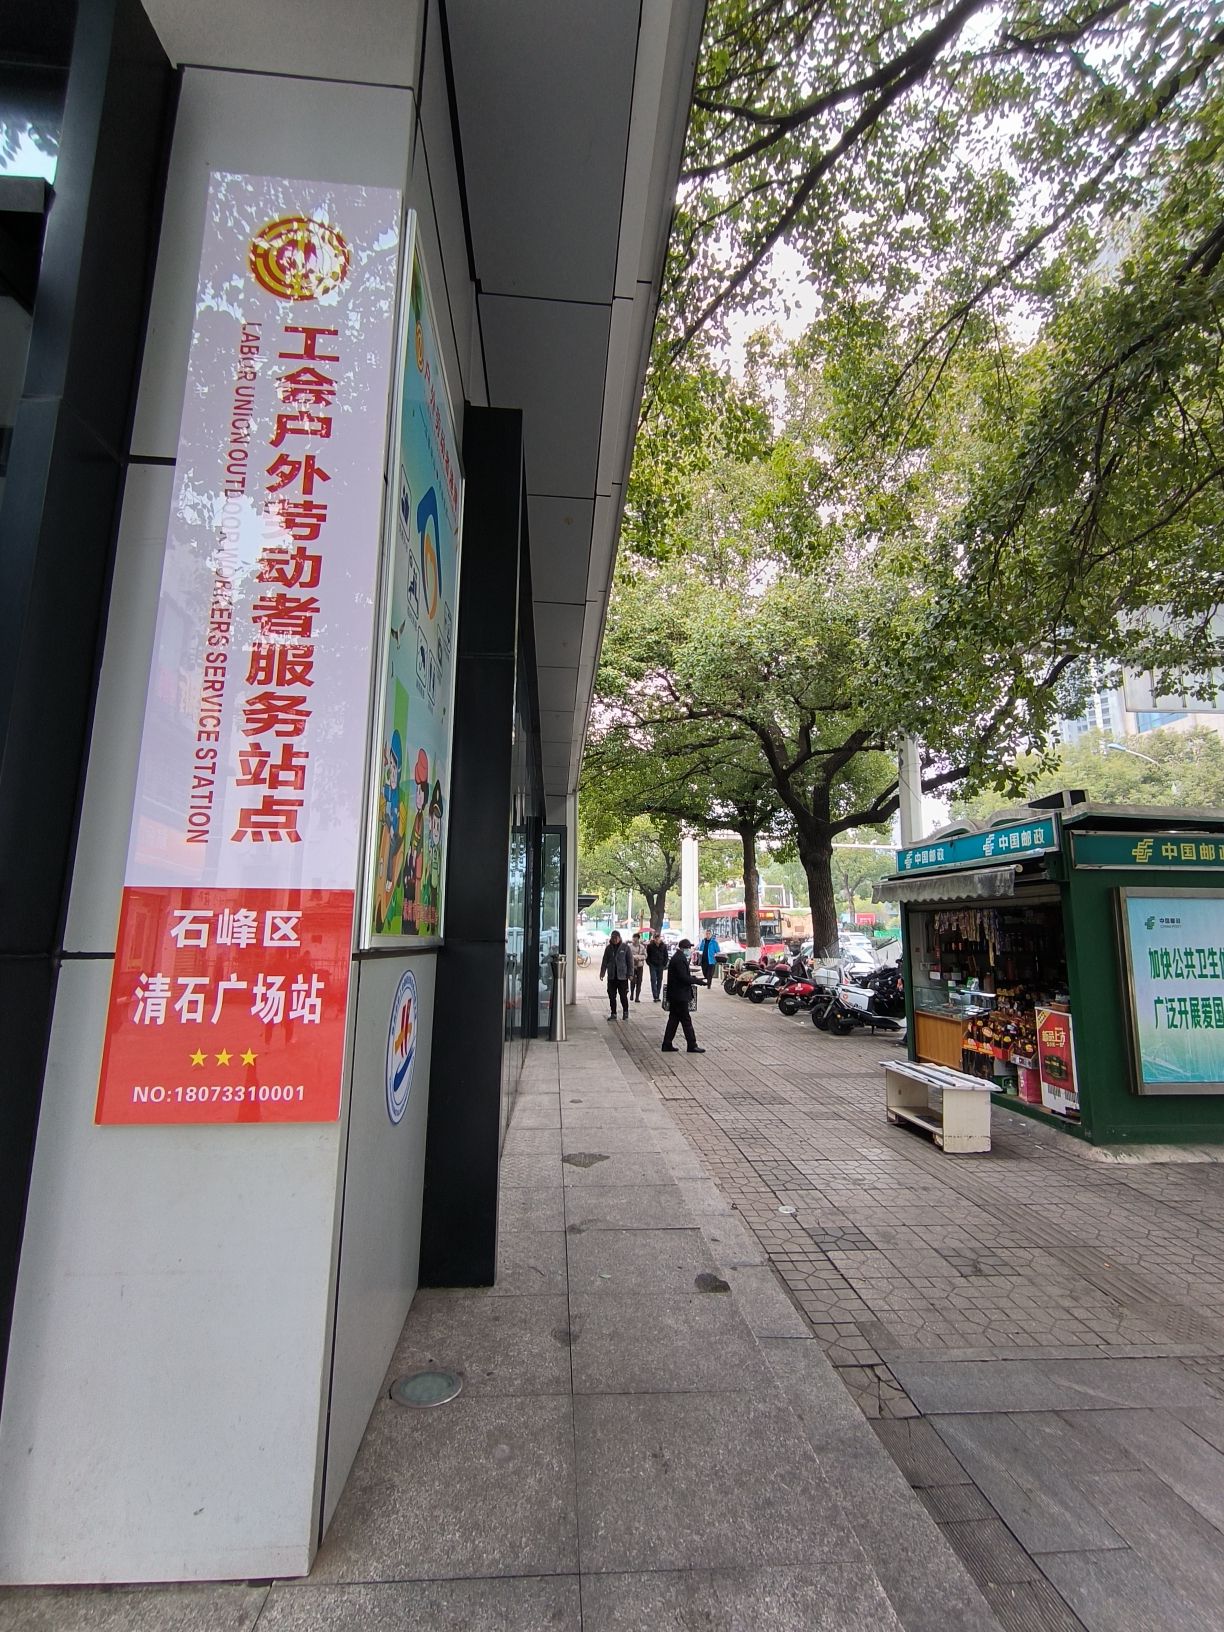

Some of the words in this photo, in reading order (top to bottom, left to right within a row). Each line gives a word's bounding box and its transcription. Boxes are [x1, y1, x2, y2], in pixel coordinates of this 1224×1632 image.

[230, 386, 255, 444] UNION
[231, 326, 339, 842] 工会户外劳动者服务站点
[197, 651, 228, 742] SERVICE
[186, 747, 218, 843] STATION
[914, 848, 945, 865] 中国邮政
[998, 827, 1045, 851] 中国邮政
[170, 908, 303, 949] 石峰区
[132, 973, 326, 1026] 清石广场站
[1154, 996, 1224, 1030] 广泛开展爱国
[132, 1084, 305, 1103] NO:18073310001
